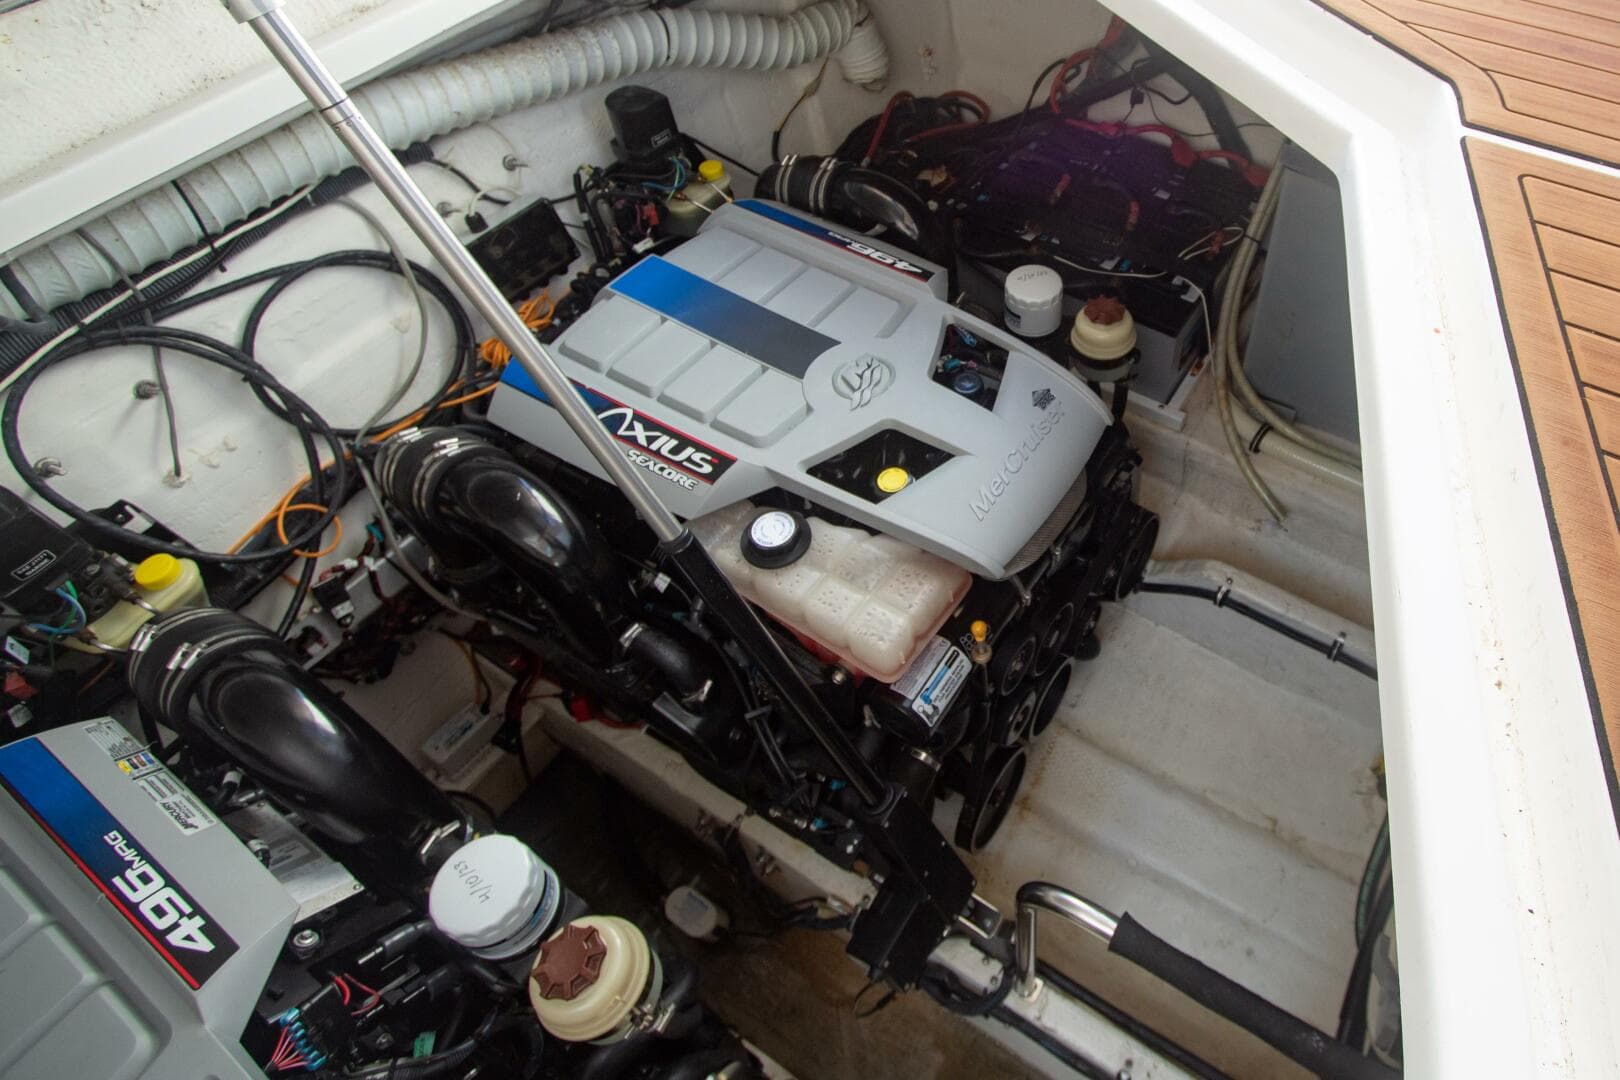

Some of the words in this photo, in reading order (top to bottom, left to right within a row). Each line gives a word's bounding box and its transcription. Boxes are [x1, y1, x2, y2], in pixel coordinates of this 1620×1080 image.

[845, 240, 923, 273] 496
[597, 407, 714, 474] AXIUS
[626, 449, 699, 491] SEACORE
[103, 830, 147, 870] MAG
[453, 860, 492, 904] 4/10/23
[111, 862, 216, 953] 496
